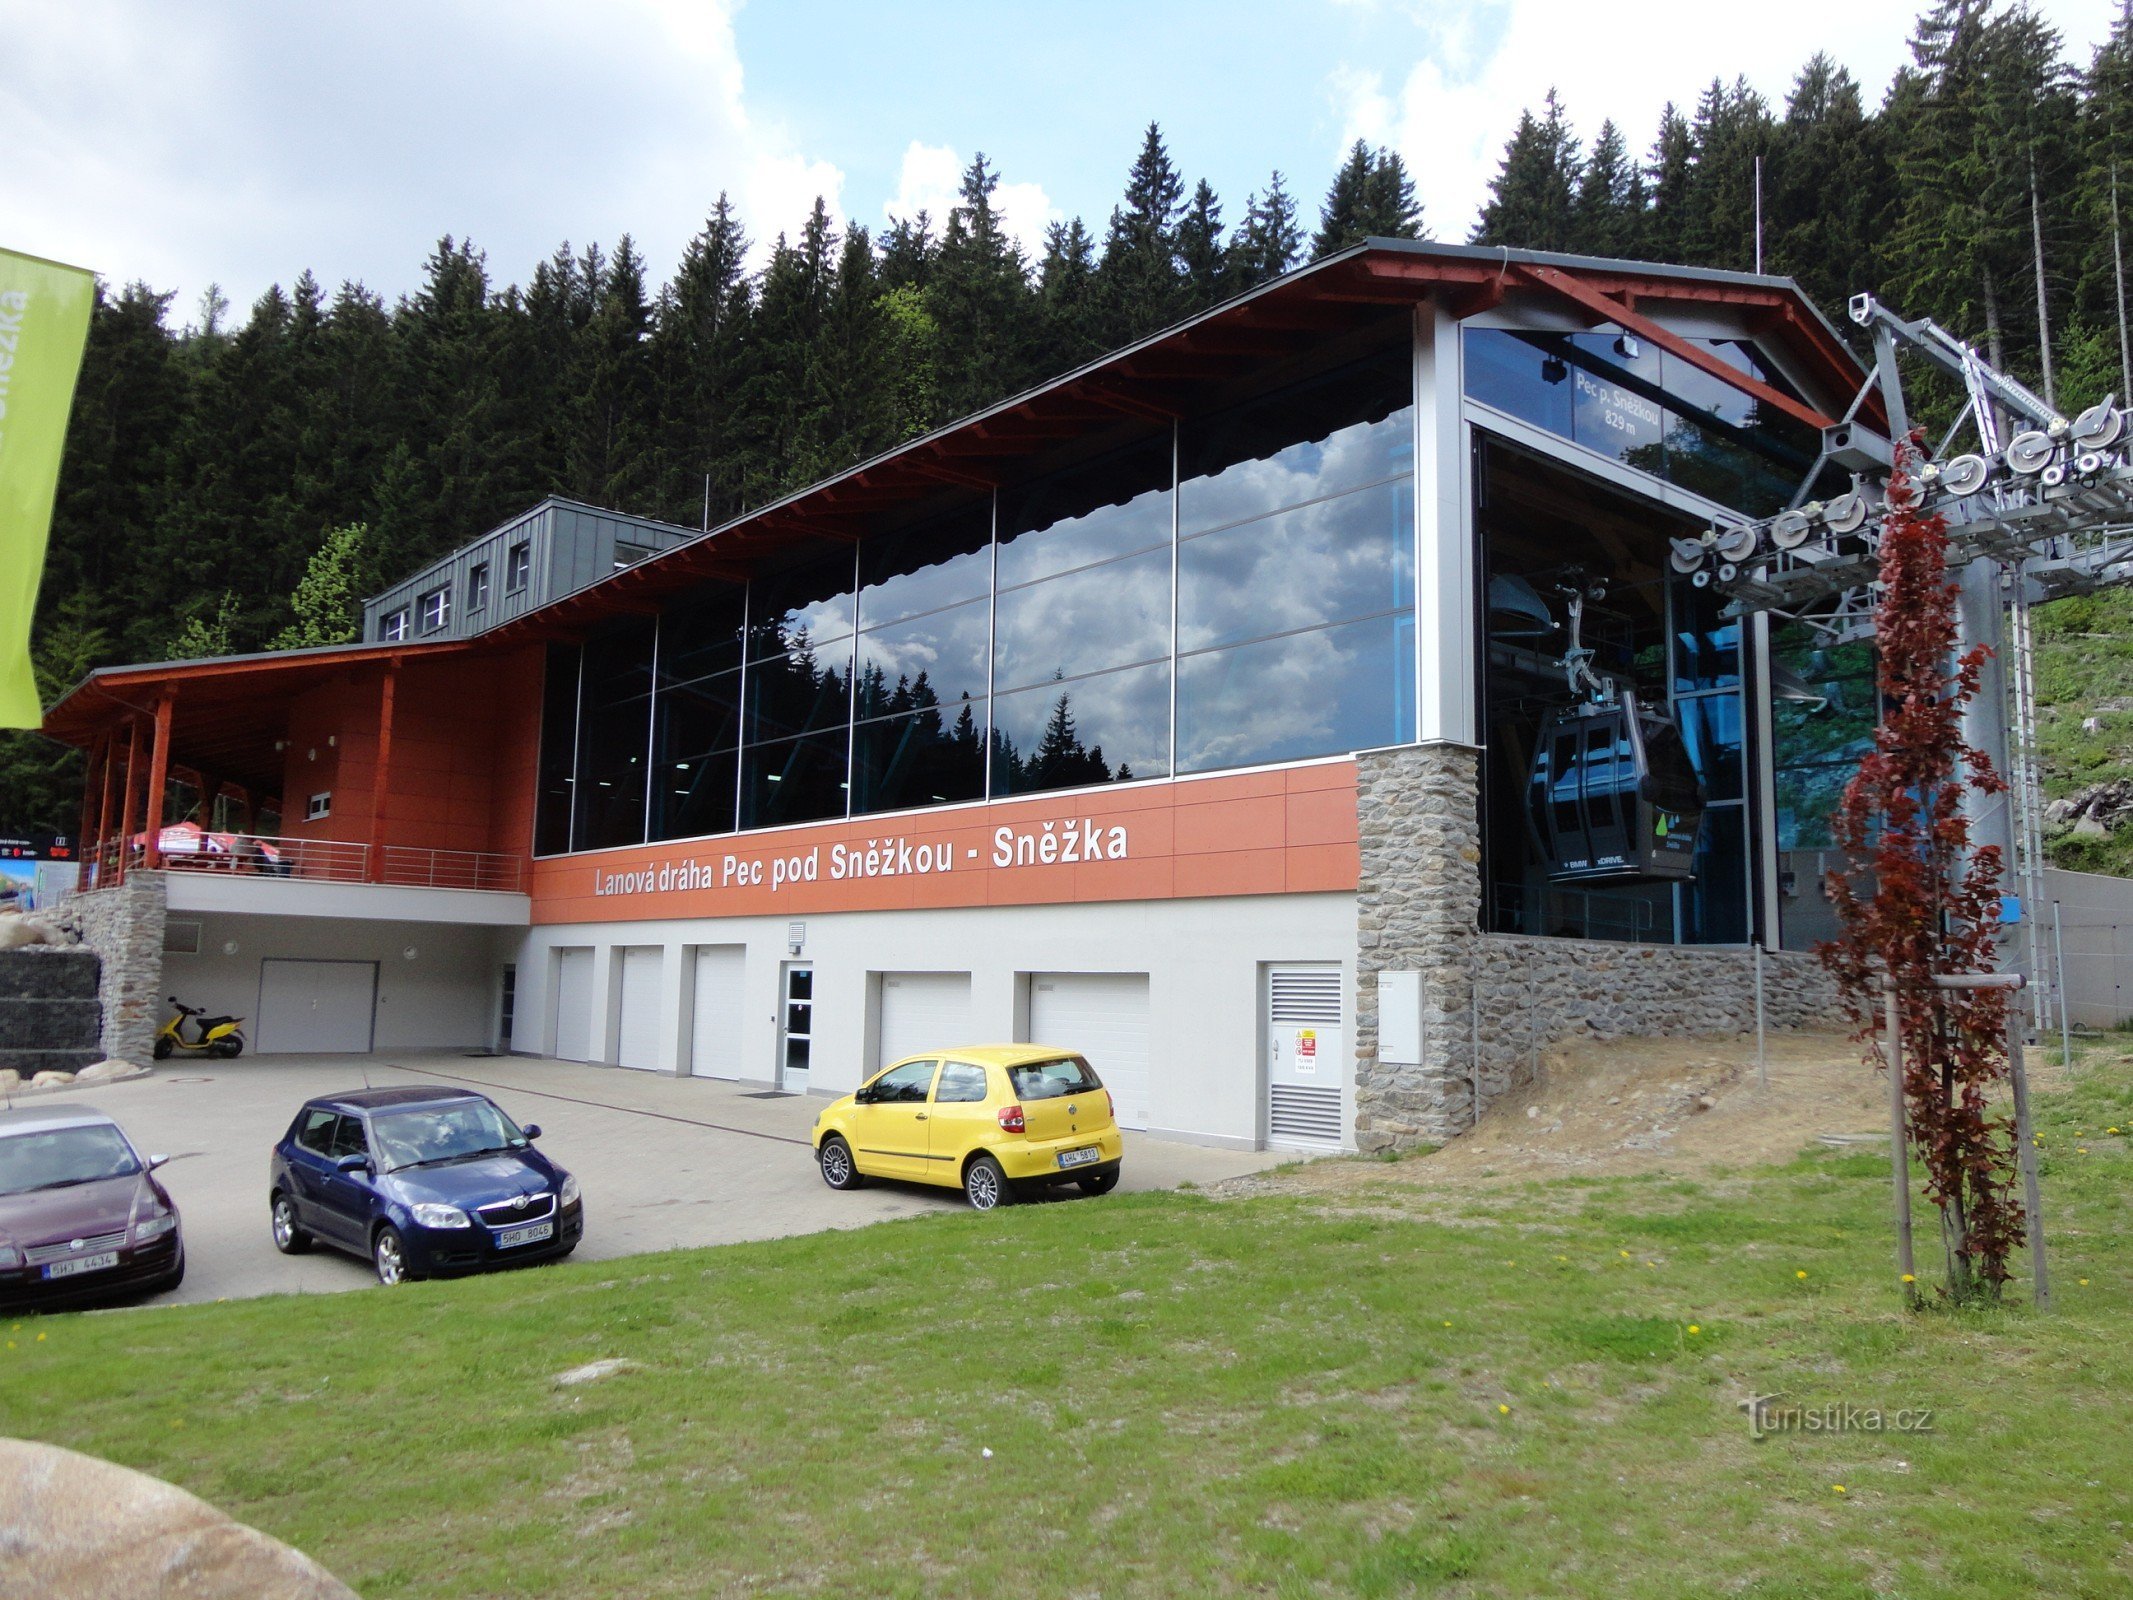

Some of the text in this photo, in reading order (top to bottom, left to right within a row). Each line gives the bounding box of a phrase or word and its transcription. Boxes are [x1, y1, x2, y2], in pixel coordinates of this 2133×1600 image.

[1577, 372, 1659, 427] Pec p. Sněžkou
[1605, 409, 1636, 436] 829 m
[595, 819, 1128, 896] Lanová dráha Pec pod Sněžkou - Sněžka
[527, 1225, 549, 1239] 8046
